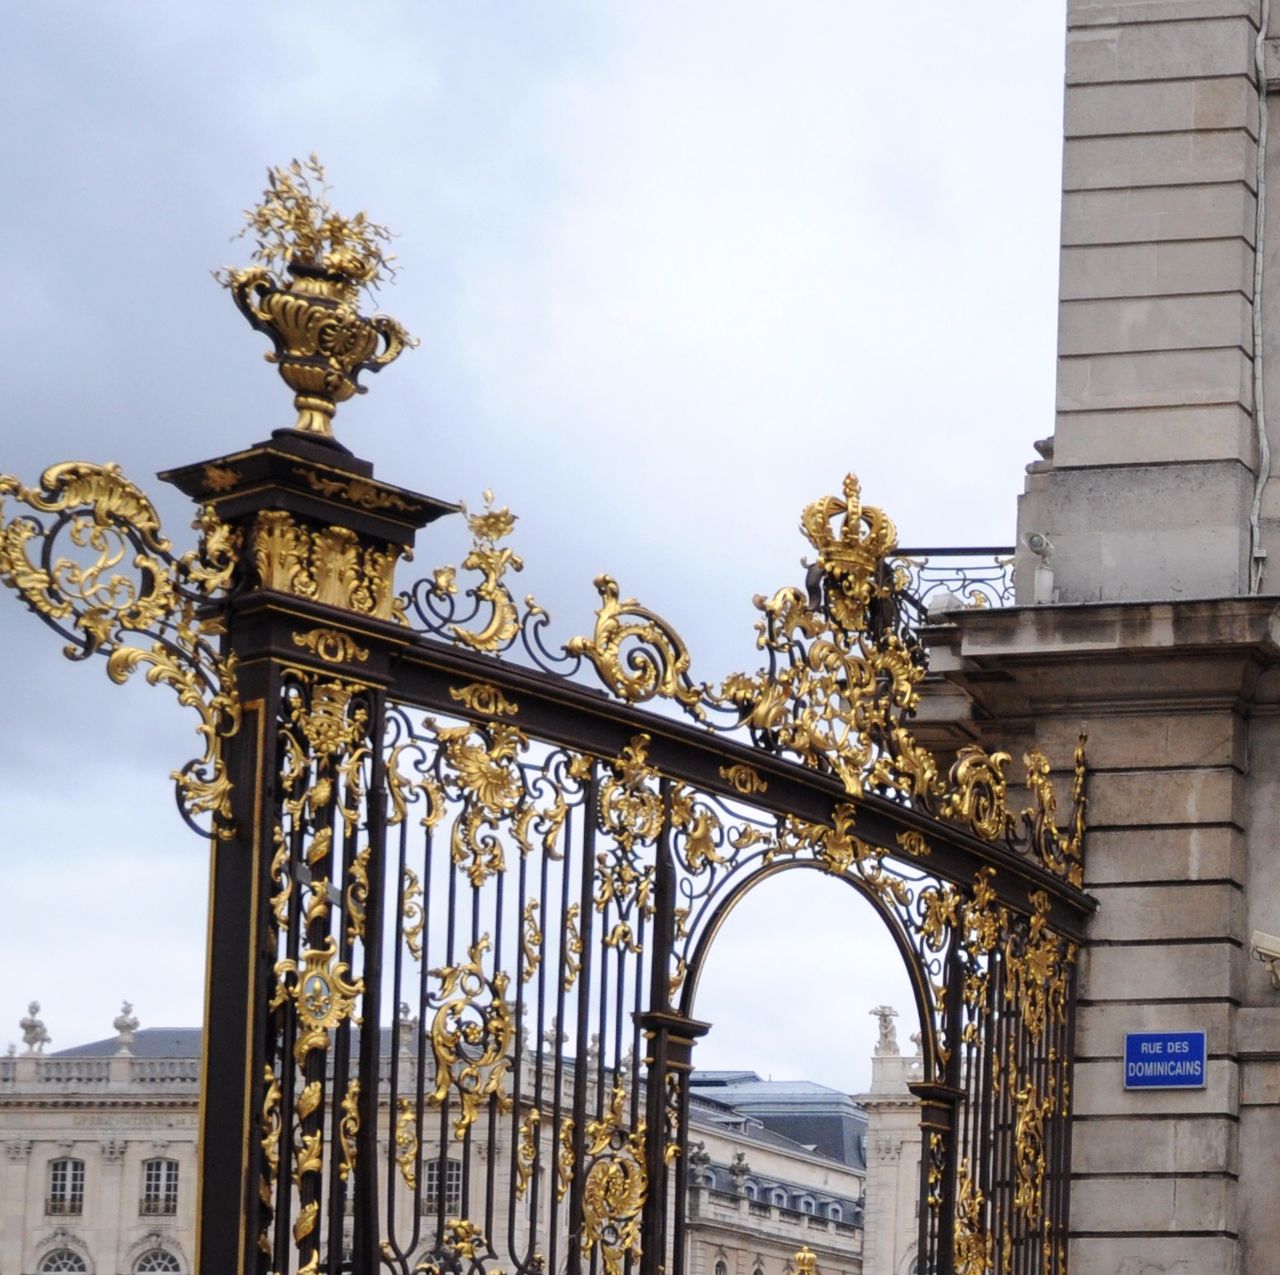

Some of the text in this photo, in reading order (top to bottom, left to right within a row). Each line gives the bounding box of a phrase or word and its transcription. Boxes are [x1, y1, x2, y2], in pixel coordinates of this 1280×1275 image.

[1141, 1041, 1189, 1053] RUE DES
[1128, 1060, 1201, 1077] DOMINICAINS
